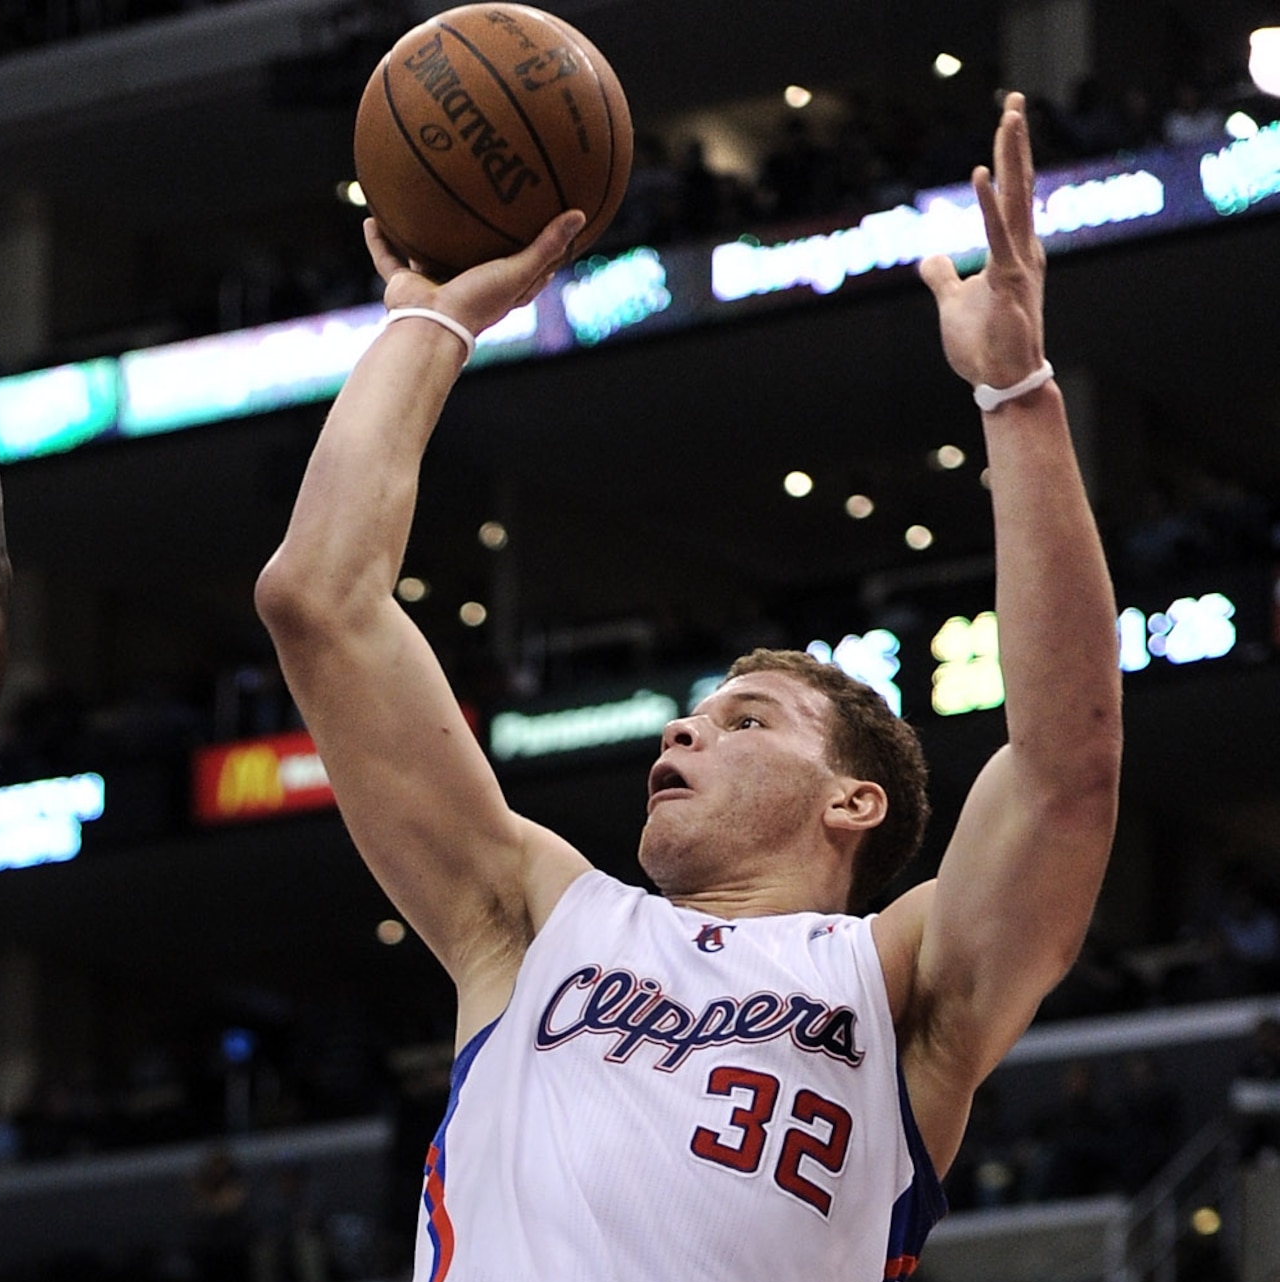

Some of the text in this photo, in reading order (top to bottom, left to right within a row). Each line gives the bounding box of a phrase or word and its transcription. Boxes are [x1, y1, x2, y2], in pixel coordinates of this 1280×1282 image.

[404, 33, 541, 204] SPALDING
[534, 963, 866, 1070] Clippers
[691, 1066, 853, 1217] 32
